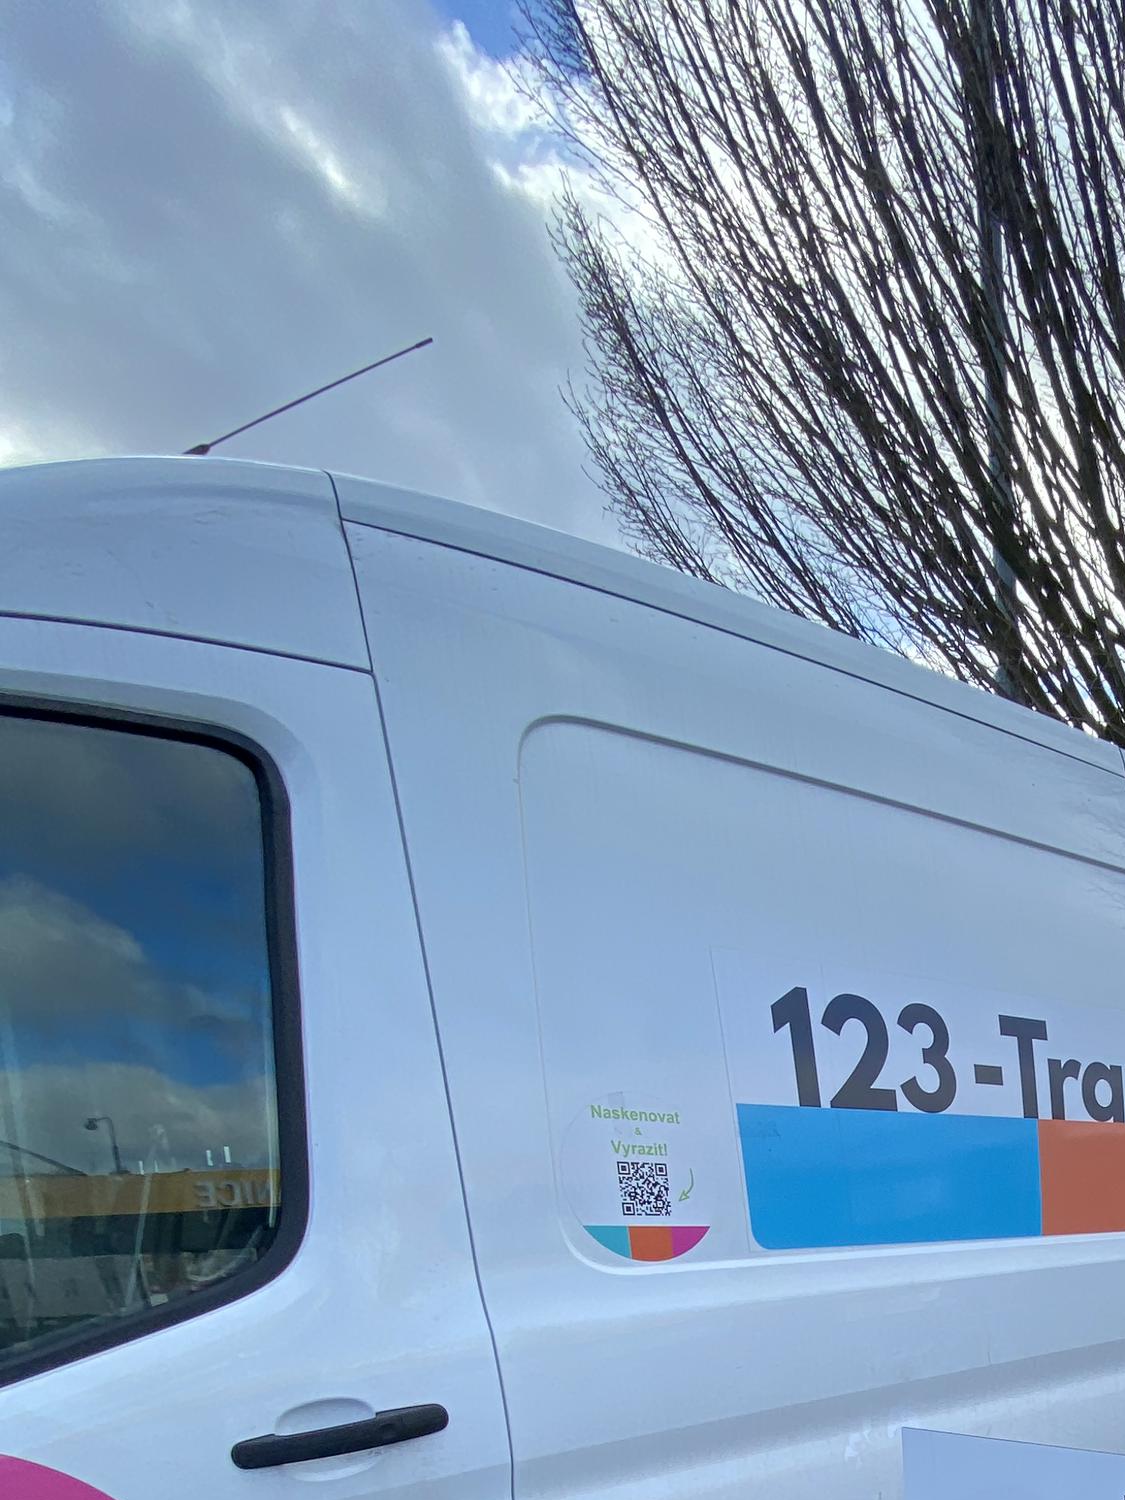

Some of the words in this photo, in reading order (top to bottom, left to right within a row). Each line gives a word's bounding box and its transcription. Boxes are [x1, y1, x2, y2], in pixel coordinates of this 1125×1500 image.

[590, 1104, 681, 1125] Naskenovat
[634, 1127, 643, 1136] &
[610, 1139, 669, 1158] Vyrazit!
